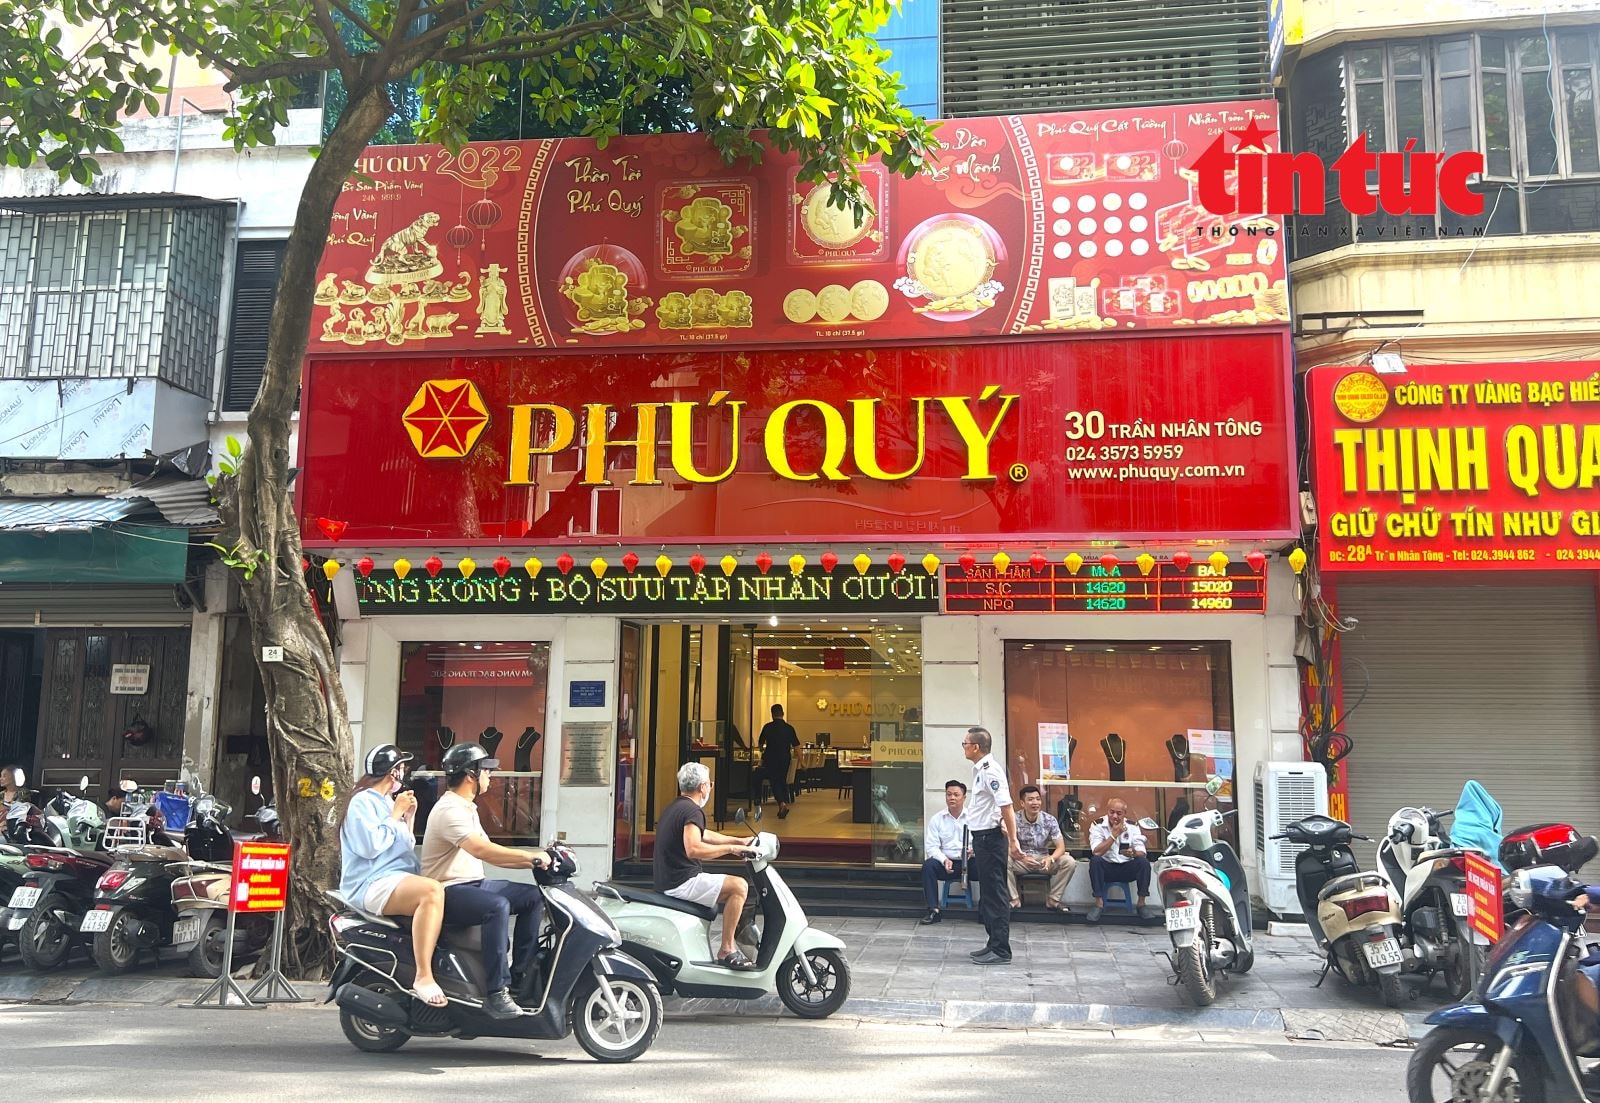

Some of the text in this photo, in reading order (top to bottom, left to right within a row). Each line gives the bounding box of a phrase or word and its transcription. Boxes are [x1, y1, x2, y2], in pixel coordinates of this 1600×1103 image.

[1036, 122, 1066, 137] Phú
[1068, 121, 1100, 141] Quý
[353, 153, 433, 174] HÚ QUÝ
[436, 145, 522, 188] 2022
[564, 156, 610, 183] Thần
[567, 189, 645, 218] Phú Quý
[1394, 380, 1444, 406] CÔNG
[1448, 384, 1470, 405] TY
[1474, 379, 1523, 405] VÀNG
[1527, 380, 1565, 407] BẠC
[503, 389, 748, 487] PHÚ
[764, 385, 1020, 484] QUÝ
[1064, 410, 1263, 440] 30 TRẦN NHÂN TÔNG
[1066, 444, 1184, 461] 024 3573 5959
[1333, 423, 1600, 505] THỊNH QUA
[1068, 463, 1245, 482] www.phuquy.com.vn
[1330, 506, 1378, 538] GIỮ
[1385, 505, 1441, 538] CHỮ
[1449, 505, 1495, 538] TÍN
[1502, 511, 1562, 538] NHƯ
[1397, 549, 1420, 562] Nhân
[1422, 550, 1444, 563] Tông
[1452, 549, 1470, 561] Tel:
[1516, 549, 1536, 561] 862
[1555, 549, 1575, 561] 024
[545, 573, 591, 605] BỘ
[670, 573, 730, 605] TẬP
[985, 581, 1233, 594] SJC 14620 15020
[983, 597, 1233, 611] NPQ 14620 14960
